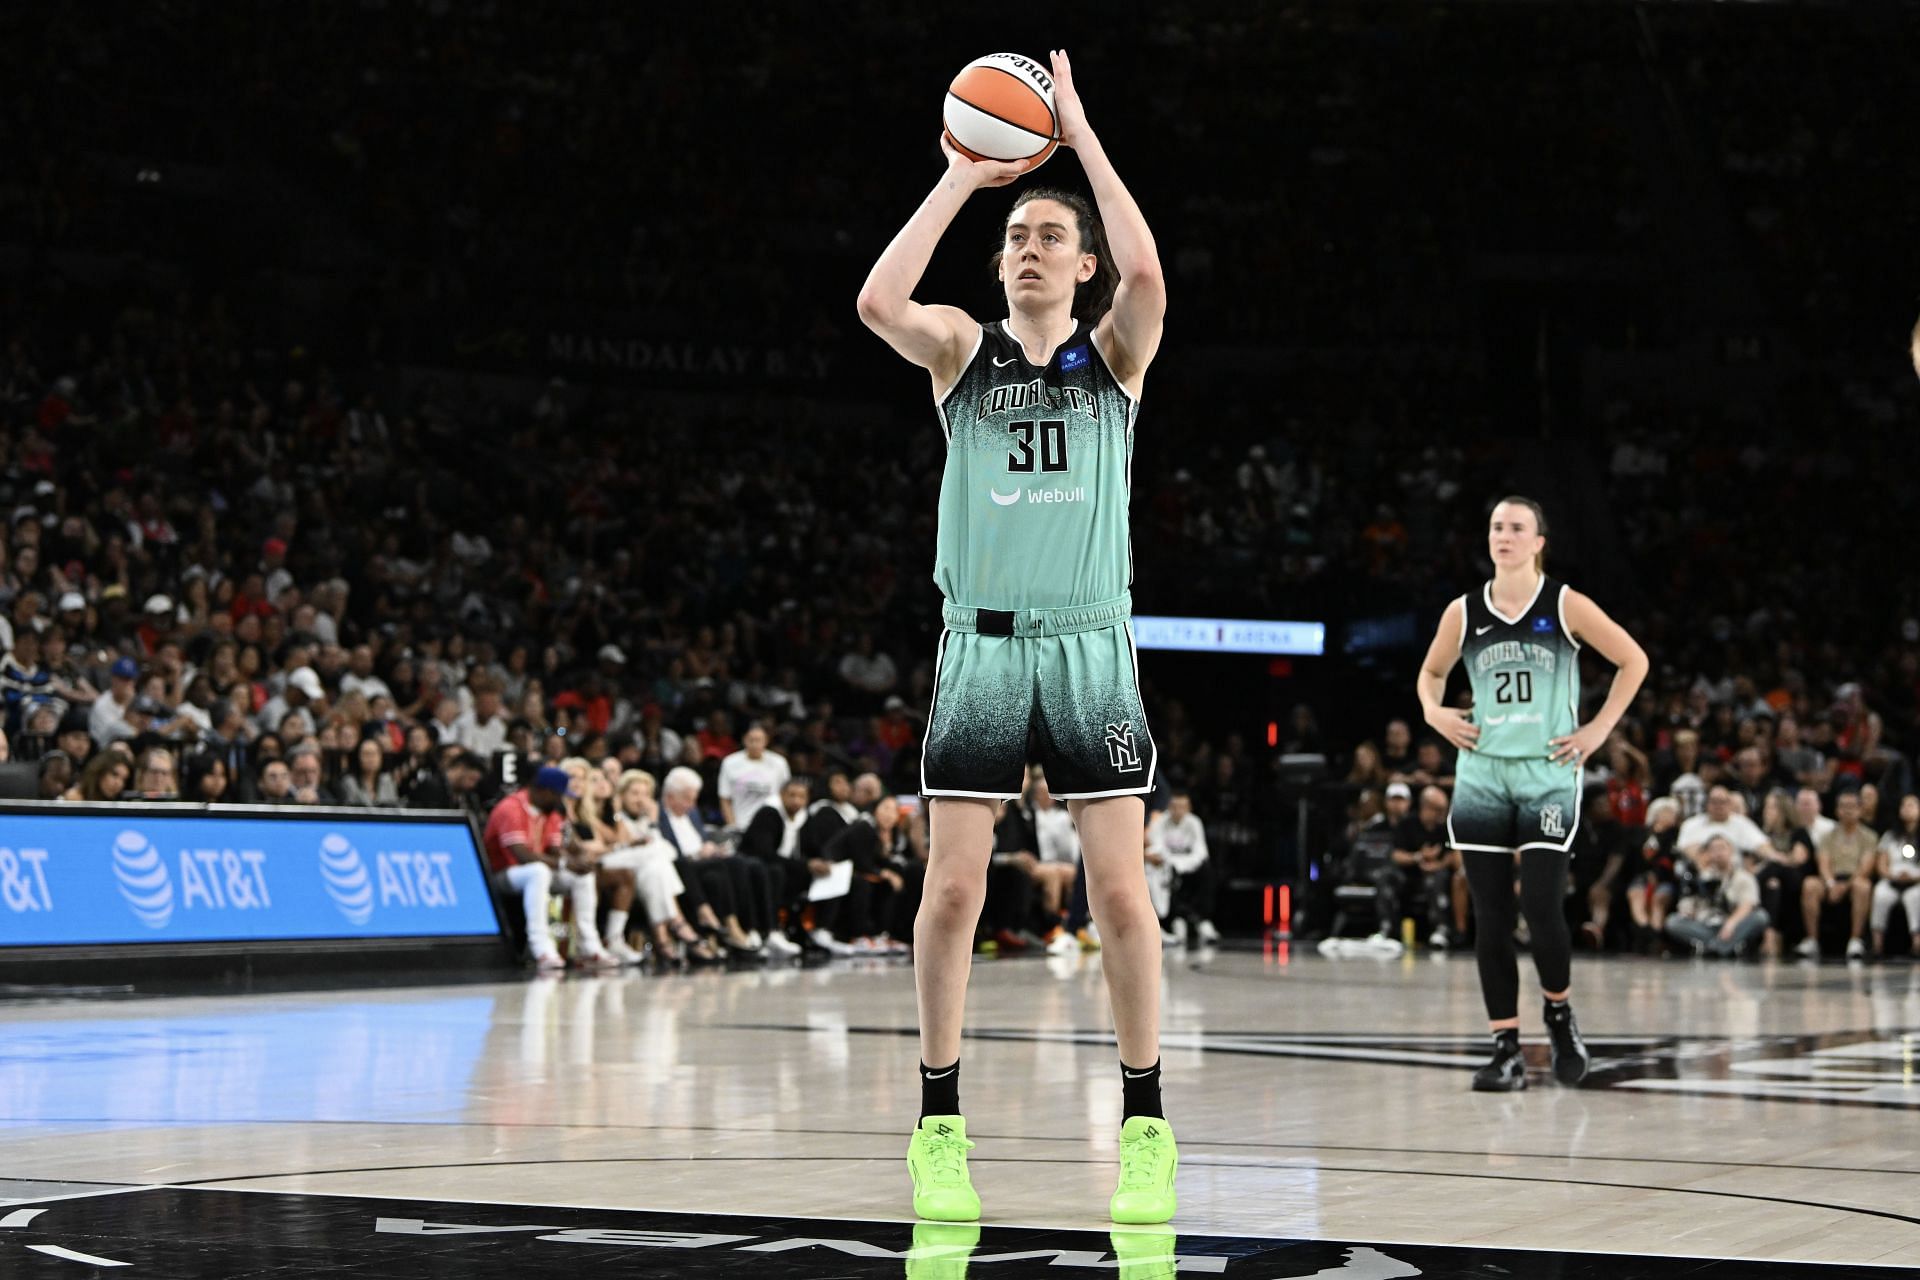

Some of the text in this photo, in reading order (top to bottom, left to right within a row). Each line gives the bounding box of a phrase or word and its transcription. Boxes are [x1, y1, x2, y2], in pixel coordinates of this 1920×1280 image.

[549, 332, 831, 378] MANDALAY BY
[976, 377, 1098, 425] EQUALTY
[1007, 419, 1069, 473] 30
[1027, 487, 1085, 504] Webull
[1475, 641, 1556, 677] EQUALTY
[1495, 671, 1532, 704] 20
[179, 848, 272, 910] AT&T
[376, 850, 458, 907] AT&T
